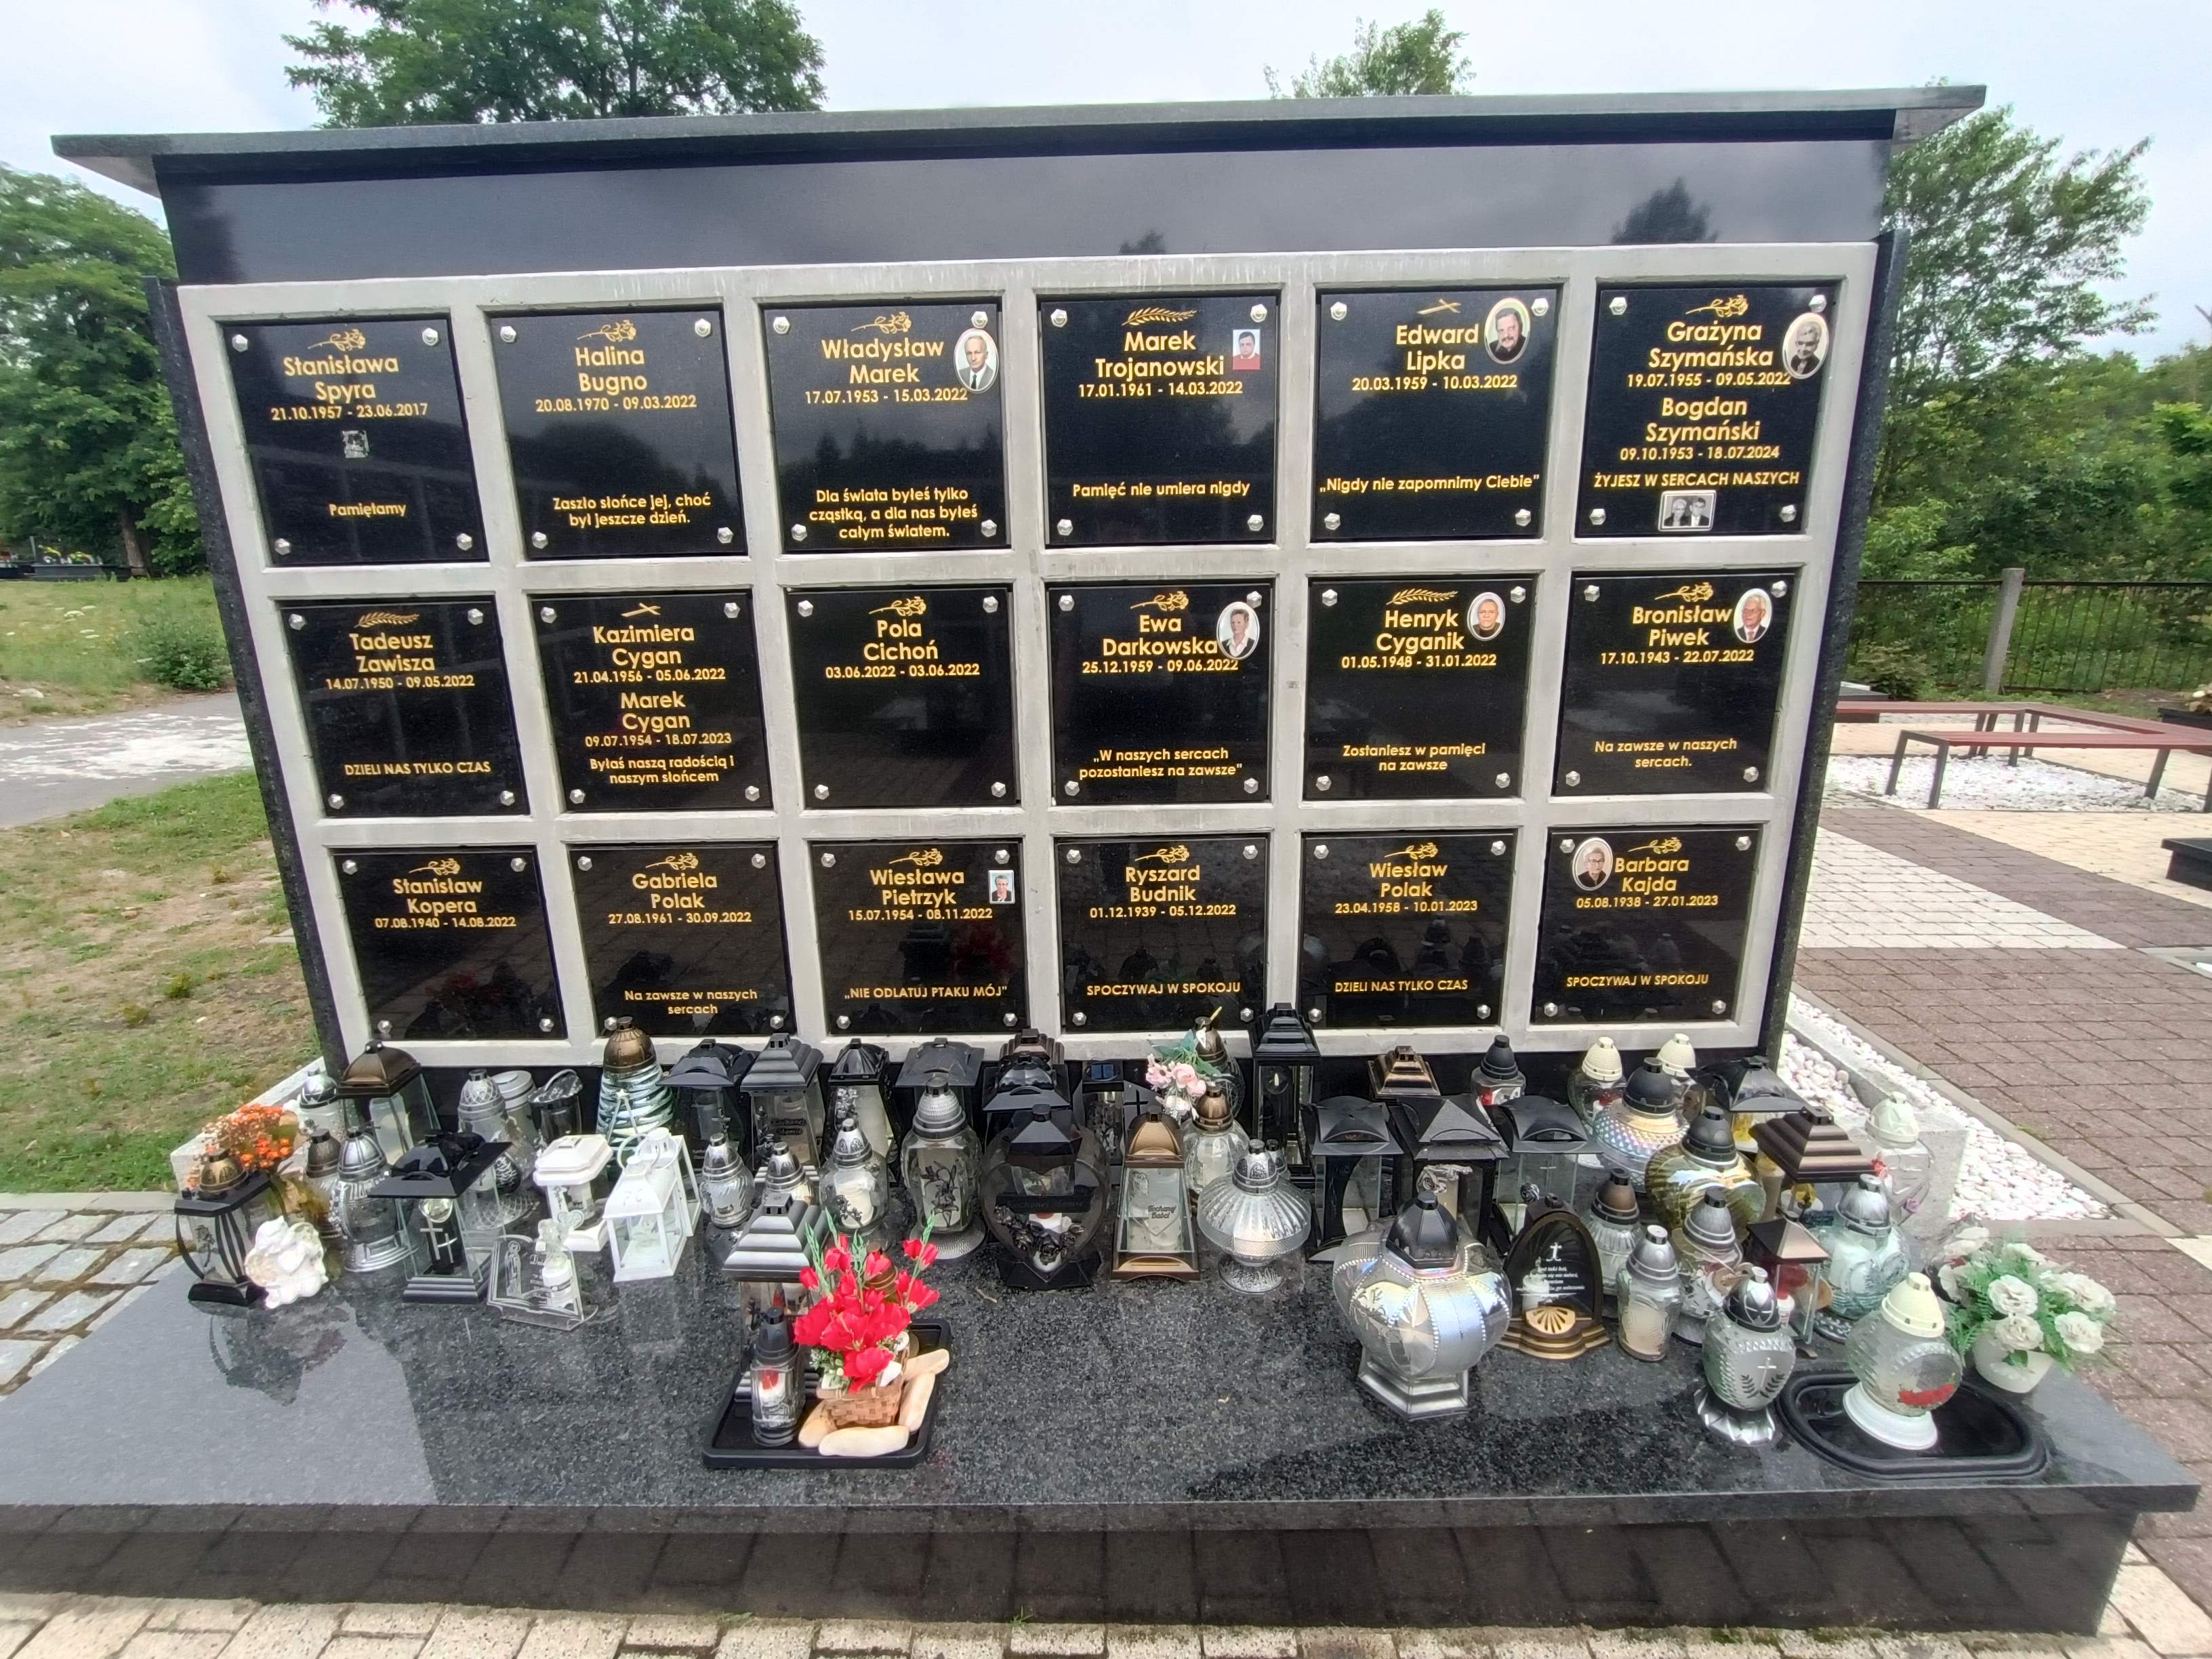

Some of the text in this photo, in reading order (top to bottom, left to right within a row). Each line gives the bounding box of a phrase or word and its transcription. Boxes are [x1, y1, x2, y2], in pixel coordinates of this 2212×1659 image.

[1124, 330, 1196, 352] Marek
[1396, 324, 1479, 345] Edward
[1667, 320, 1762, 346] Grażyna
[575, 346, 645, 367] Halina
[821, 338, 944, 362] Władysław
[1648, 345, 1773, 371] Szymańska
[283, 354, 399, 377] Stanisława
[1095, 355, 1224, 382] Trojanowski
[1406, 350, 1465, 375] Lipka
[849, 363, 920, 384] Marek
[1351, 373, 1518, 391] 20.03.1959 10.03.2022
[1627, 372, 1791, 388] 19.07.1955 09.05.2022
[314, 381, 376, 405] Spyra
[578, 372, 648, 396] Bugno
[1079, 380, 1244, 398] 17.01.1961 14.03.2022
[535, 394, 697, 413] 20.08.1970 09.03.2022
[806, 387, 968, 405] 17.07.1953 15.03.2022
[270, 403, 428, 421] 21.10.1957 23.06.2017
[1661, 396, 1748, 421] Bogdan
[1645, 419, 1761, 446] Szymański
[1620, 445, 1781, 461] 09.10.1953 18.07.2024
[1372, 476, 1395, 491] nie
[1397, 476, 1483, 493] zapomnimy
[1593, 471, 1801, 488] ŻYJESZ SERCACH NASZYCH
[816, 487, 968, 504] Dla świata byłeś tylko
[1072, 480, 1251, 499] Pamięć nie umiera nigdy
[328, 501, 407, 518] Pamiętamy
[553, 491, 712, 510] Zaszło słońce jej, choć
[569, 509, 691, 529] był jeszcze dzień.
[808, 503, 978, 524] cząstką, dla nas byłeś
[838, 523, 950, 541] całym światem.
[1139, 615, 1182, 632] Ewa
[1385, 609, 1458, 631] Henryk
[1632, 605, 1733, 624] Bronisław
[592, 623, 695, 644] Kazimiera
[876, 619, 922, 638] Pola
[1648, 628, 1710, 647] Piwek
[348, 632, 434, 651] Tadeusz
[863, 639, 939, 661] Cichoń
[1102, 636, 1218, 656] Darkowska
[1376, 632, 1465, 655] Cyganik
[355, 654, 436, 673] Zawisza
[612, 648, 682, 670] Cygan
[1340, 653, 1497, 669] 01.05.1948 31.01.2022
[1600, 649, 1755, 665] 17.10.1943 22.07.2022
[573, 667, 726, 684] 21.04.1956 05.06.2022
[825, 662, 981, 679] 03.06.2022 03.06.2022
[1082, 659, 1239, 674] 25.12.1959 09.06.2022
[325, 674, 476, 691] 14.07.1950 09.05.2022
[621, 691, 687, 710] Marek
[621, 712, 691, 733] Cygan
[584, 732, 733, 747] 09.07.1954 18.07.2023
[1594, 737, 1738, 753] Na zawsze naszych
[1115, 747, 1171, 763] naszych
[1174, 747, 1229, 760] sercach
[1342, 742, 1486, 758] Zostaniesz pamięci
[344, 760, 492, 776] DZIELI NAS TYLKO CZAS
[589, 754, 728, 772] Byłaś naszą radością
[1378, 760, 1448, 771] na zawsze
[1635, 755, 1692, 769] sercach.
[609, 769, 719, 786] naszym słońcem
[1079, 764, 1165, 781] pozostaniesz
[1167, 766, 1185, 777] na
[1369, 861, 1448, 878] Wiesław
[1614, 856, 1689, 873] Barbara
[632, 872, 718, 889] Gabriela
[869, 869, 964, 885] Wiesława
[1125, 865, 1200, 885] Ryszard
[392, 878, 482, 895] Stanisław
[1130, 884, 1197, 903] Budnik
[1380, 881, 1433, 898] Polak
[1622, 876, 1677, 895] Kajda
[650, 892, 705, 909] Polak
[882, 888, 957, 907] Pietrzyk
[1334, 899, 1478, 914] 23.04.1958 10.01.2023
[1576, 895, 1719, 909] 05.08.1938 27.01.2023
[407, 898, 478, 917] Kopera
[848, 907, 993, 921] 15.07.1954 08.11.2022
[1089, 903, 1237, 919] 01.12.1939 05.12.2022
[374, 916, 517, 929] 07.08.1940 14.08.2022
[607, 911, 752, 924] 27.08.1961 30.09.2022
[1086, 981, 1241, 996] SPOCZYWAJ SPOKOJU
[1334, 979, 1469, 993] DZIELI NAS TYLKO CZAS
[1566, 974, 1709, 987] SPOCZYWAJ SPOKOJU
[623, 988, 758, 1002] Na zawsze naszych
[872, 987, 928, 998] ODLATUJ
[930, 986, 970, 998] PTAKU
[667, 1003, 718, 1015] sercach
